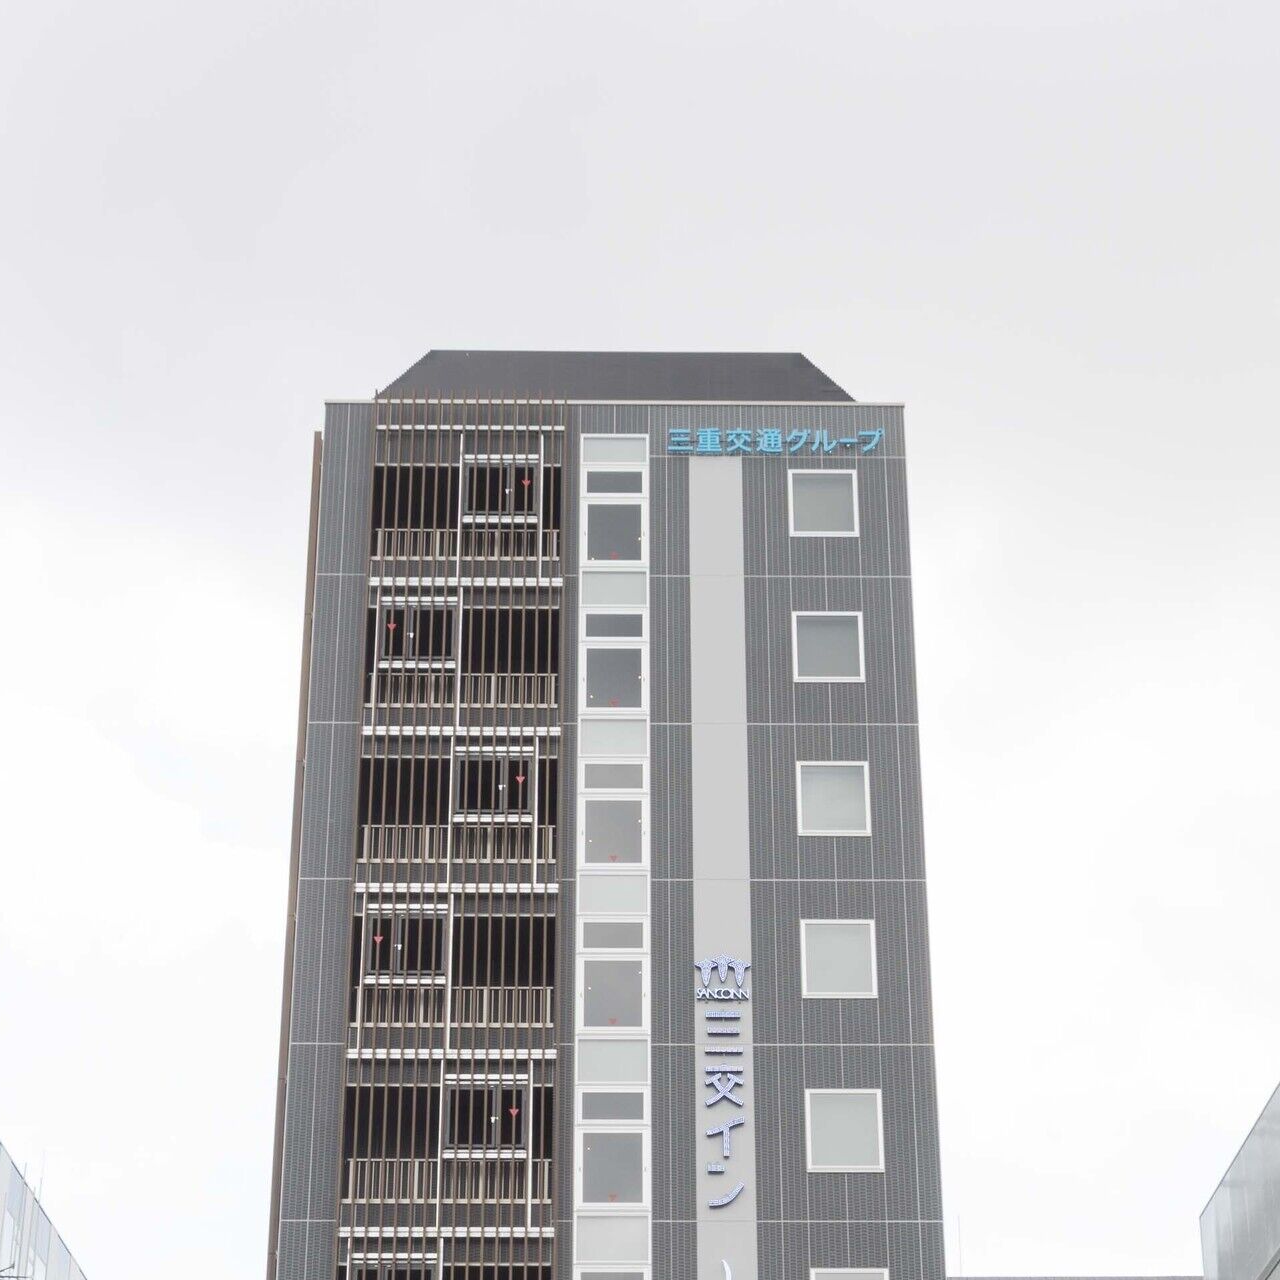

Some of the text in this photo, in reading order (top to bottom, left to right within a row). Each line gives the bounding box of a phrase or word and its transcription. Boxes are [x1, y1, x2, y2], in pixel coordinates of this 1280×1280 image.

[667, 427, 886, 455] 三重交通グループ
[696, 988, 750, 1001] SANCONN
[704, 1009, 746, 1209] 三交イン
